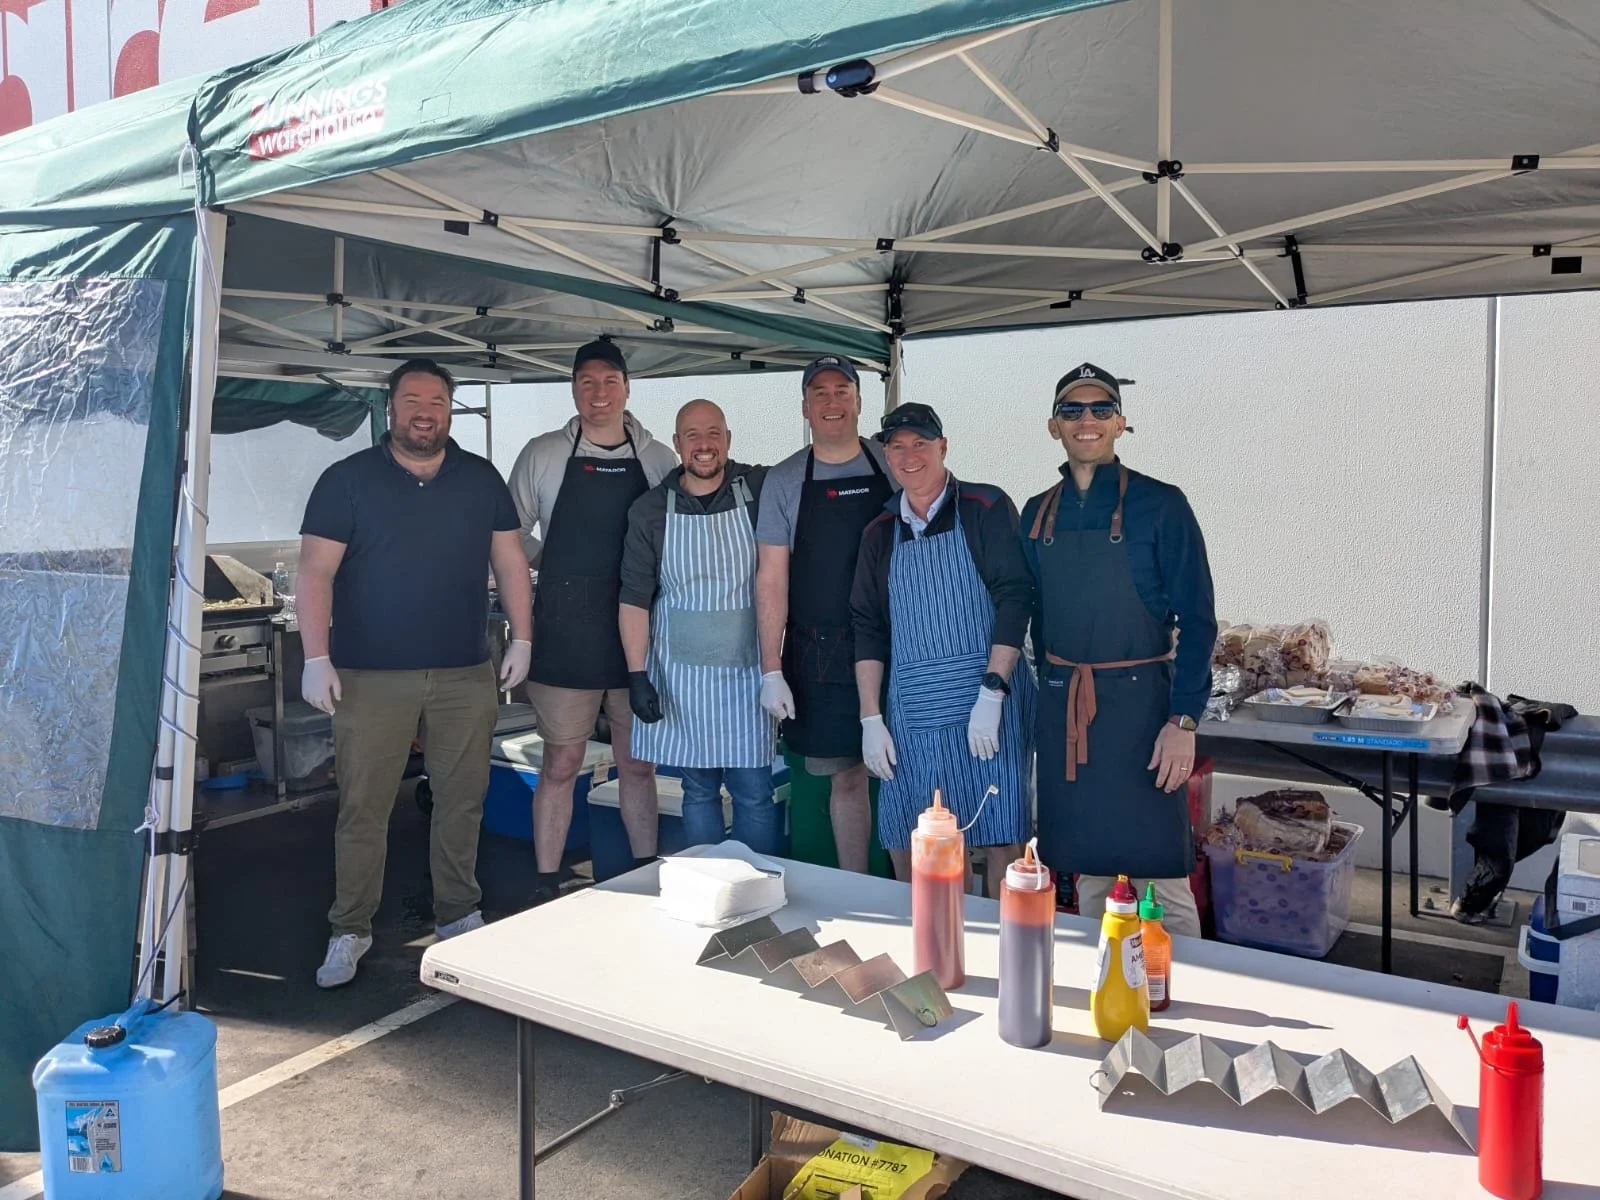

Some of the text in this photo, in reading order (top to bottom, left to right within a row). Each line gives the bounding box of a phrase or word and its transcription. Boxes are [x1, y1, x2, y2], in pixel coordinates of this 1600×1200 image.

[1079, 366, 1096, 378] LA
[838, 487, 870, 497] MATADOR
[871, 1159, 908, 1174] #7787
